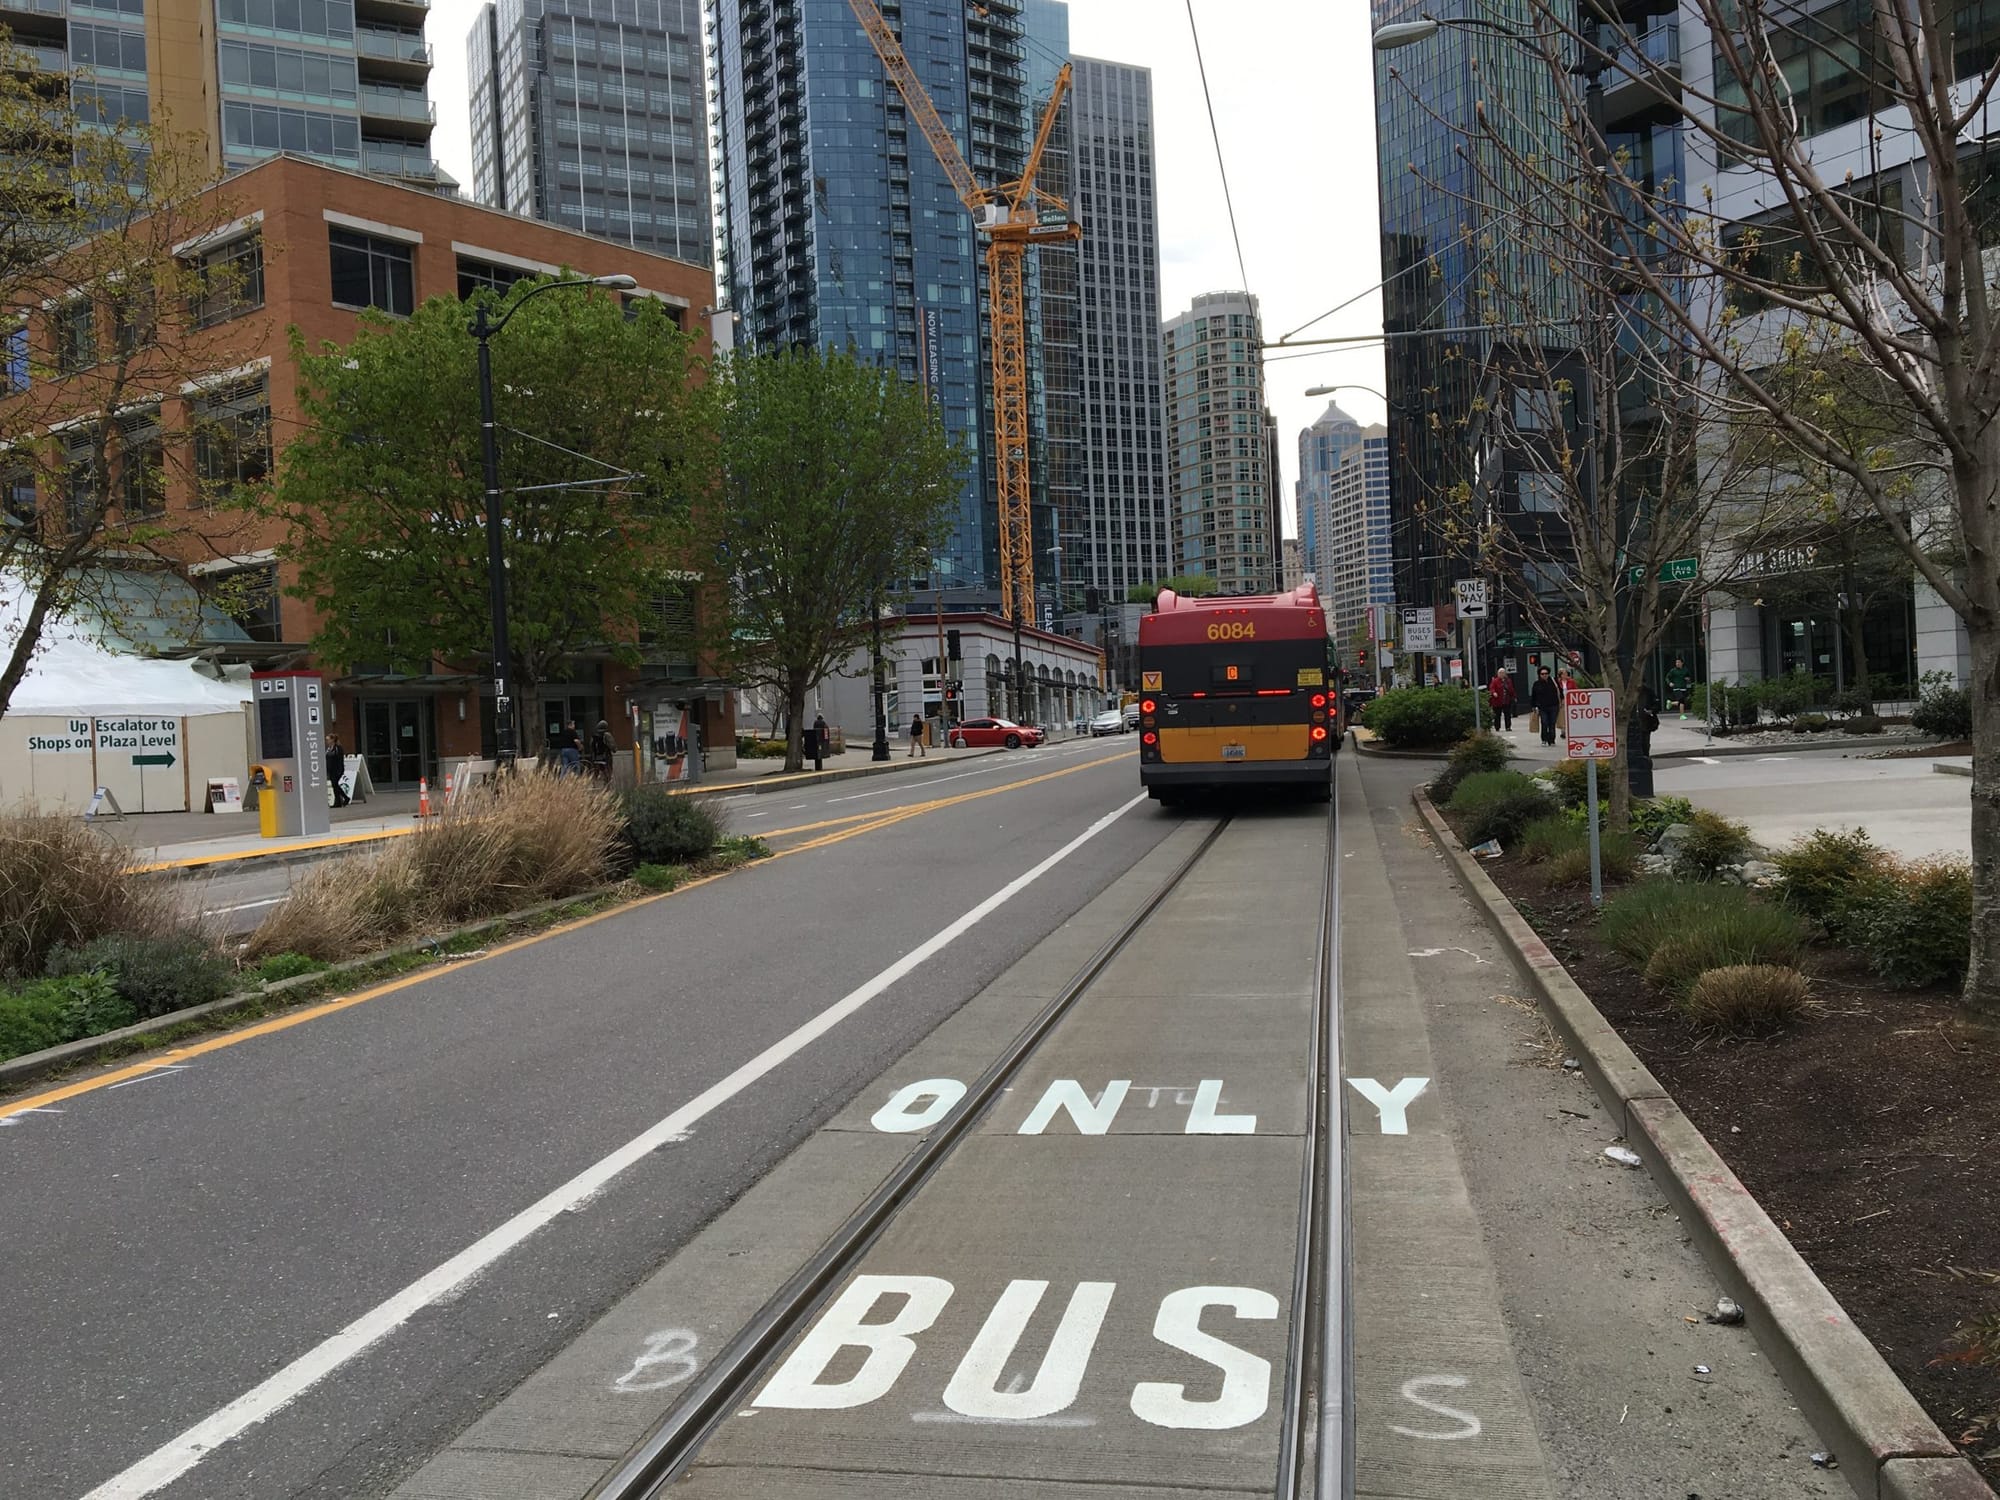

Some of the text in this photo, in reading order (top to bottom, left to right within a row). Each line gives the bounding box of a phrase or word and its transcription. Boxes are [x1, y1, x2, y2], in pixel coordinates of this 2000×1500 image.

[927, 311, 937, 337] NOW
[929, 340, 939, 383] LEASING
[1675, 565, 1692, 576] Ave
[1460, 582, 1483, 593] ONE
[1460, 593, 1484, 603] WAY
[1207, 622, 1256, 640] 6084
[1570, 692, 1588, 704] NO
[1570, 708, 1611, 719] STOPS
[70, 719, 176, 735] Up Escalator to
[28, 734, 176, 752] Shops on Plaza Level
[306, 729, 321, 788] transit
[871, 1077, 1430, 1135] ONLY
[751, 1274, 1280, 1431] BUS
